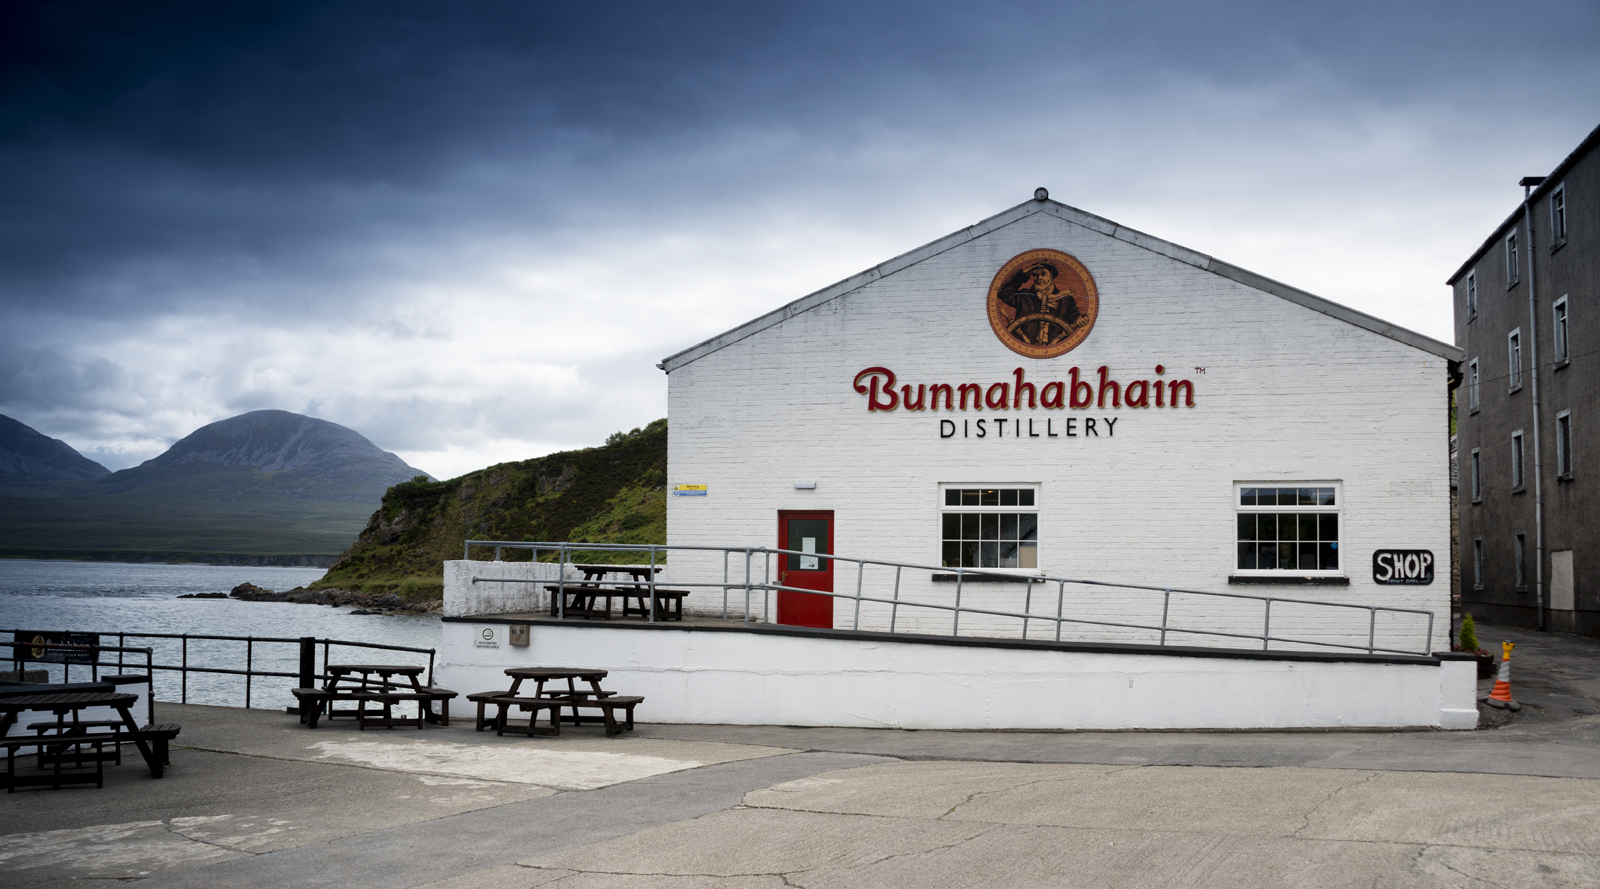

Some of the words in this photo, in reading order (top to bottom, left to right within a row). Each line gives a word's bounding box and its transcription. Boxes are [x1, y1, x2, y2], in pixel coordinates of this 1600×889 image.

[998, 257, 1025, 281] SINGLE
[1063, 257, 1083, 274] MALT
[853, 364, 1196, 411] Bunnahabhain
[940, 417, 1119, 439] DISTILLERY
[1376, 553, 1432, 581] SHOP
